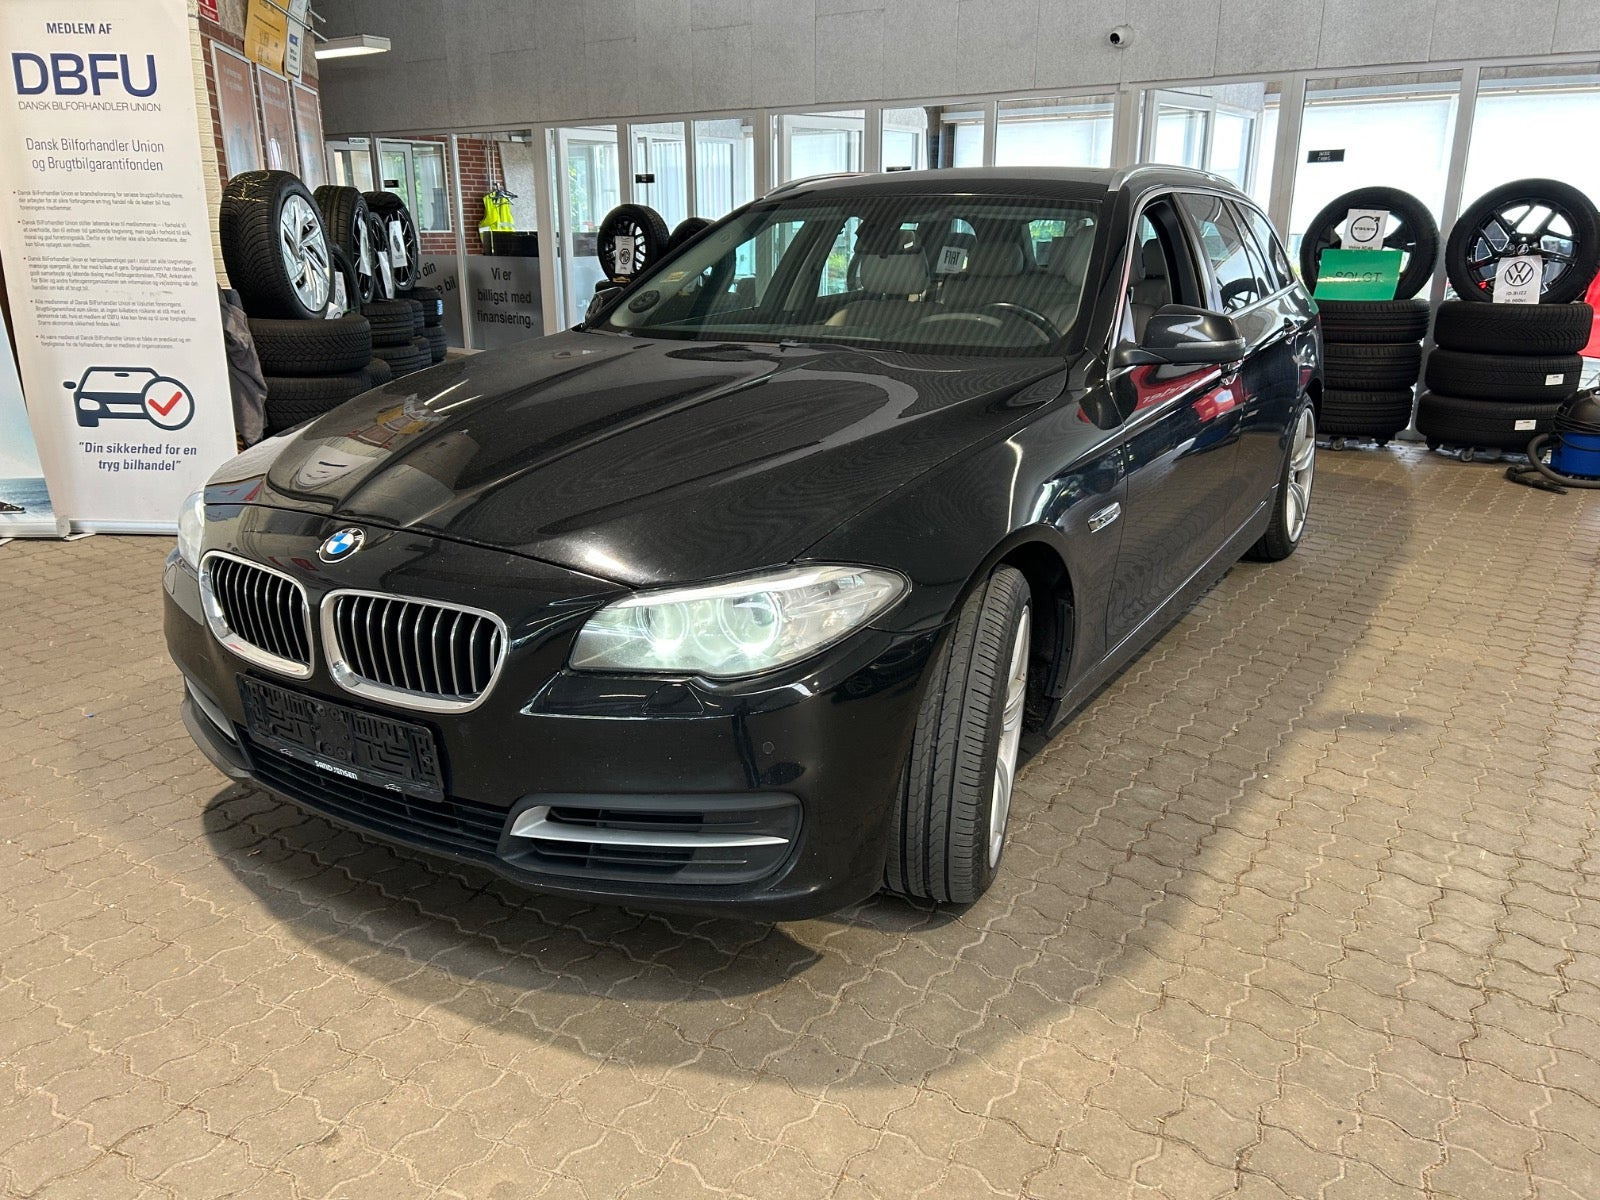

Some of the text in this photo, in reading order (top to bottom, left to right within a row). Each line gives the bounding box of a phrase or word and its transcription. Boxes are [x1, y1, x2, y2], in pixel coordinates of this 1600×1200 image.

[46, 22, 113, 35] MEDLEM AF
[11, 52, 158, 98] DBFU
[18, 101, 161, 112] DANSK BILFORHANDLER UNION
[26, 138, 165, 153] Dansk Bilforhandler Union
[32, 157, 163, 172] og Brugtbilgarantifonden
[944, 249, 961, 266] FIAT
[422, 261, 437, 277] din
[491, 267, 512, 281] Vi er
[444, 275, 456, 293] bil
[1335, 271, 1382, 283] SOLGT
[477, 289, 532, 305] billigst med
[477, 309, 535, 329] finansiering.
[106, 442, 162, 455] sikkerhed
[164, 443, 180, 455] for
[183, 445, 197, 455] en
[98, 459, 120, 472] tryg
[314, 760, 333, 772] SAND
